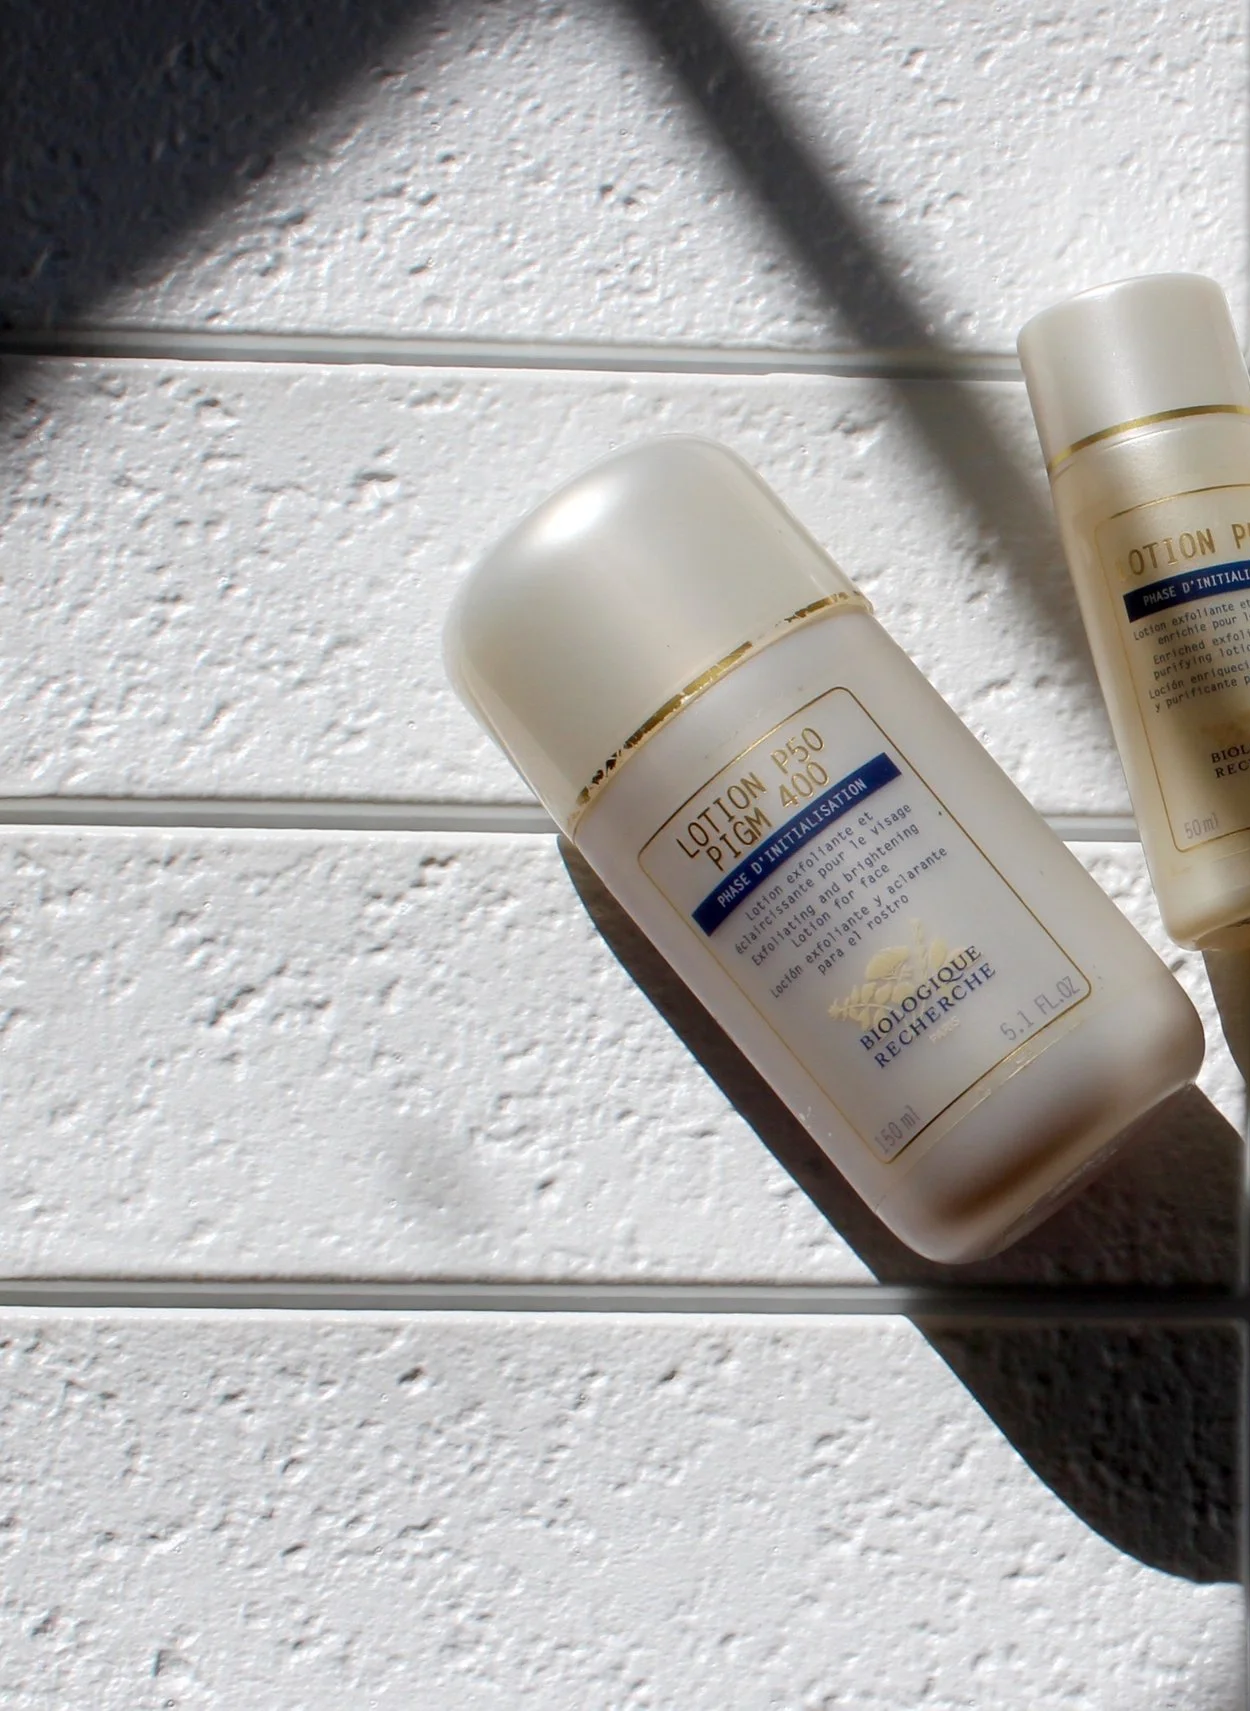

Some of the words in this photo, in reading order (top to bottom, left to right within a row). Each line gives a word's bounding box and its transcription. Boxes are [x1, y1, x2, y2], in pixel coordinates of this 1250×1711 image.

[1134, 622, 1166, 641] Lotion
[1172, 603, 1234, 626] exfoliante
[1143, 586, 1176, 606] PHASE
[1158, 622, 1206, 645] enrichie
[1213, 615, 1237, 630] pour
[1149, 678, 1184, 700] Loción
[1153, 640, 1205, 665] Enriched
[1153, 652, 1212, 680] purifying
[1155, 702, 1161, 713] y
[1165, 678, 1238, 710] purificante
[676, 772, 767, 858] LOTION
[770, 727, 824, 775] P50
[706, 807, 773, 872] PIGM
[779, 762, 830, 808] 400
[716, 872, 751, 908] PHASE
[751, 778, 868, 874] D'INITIALISATION
[736, 878, 815, 954] éclaircissante
[818, 851, 846, 880] pour
[850, 834, 867, 850] le
[870, 803, 912, 836] visage
[745, 885, 783, 922] Lotion
[786, 826, 854, 884] exfoliante
[858, 811, 874, 826] et
[751, 904, 816, 967] Exfoliating
[818, 882, 840, 904] and
[842, 822, 920, 883] brightening
[770, 966, 803, 999] Loción
[806, 906, 870, 965] exfoliante
[873, 895, 883, 907] y
[887, 846, 949, 895] aclarante
[790, 911, 832, 948] Lotion
[834, 888, 854, 910] for
[860, 863, 891, 889] face
[818, 946, 846, 976] para
[848, 930, 862, 947] el
[866, 893, 910, 930] rostro
[860, 945, 983, 1052] BIOLOGIQUE
[874, 962, 996, 1069] RECHERCHE
[1000, 1010, 1035, 1042] 5.1
[1034, 975, 1081, 1016] FL.OZ
